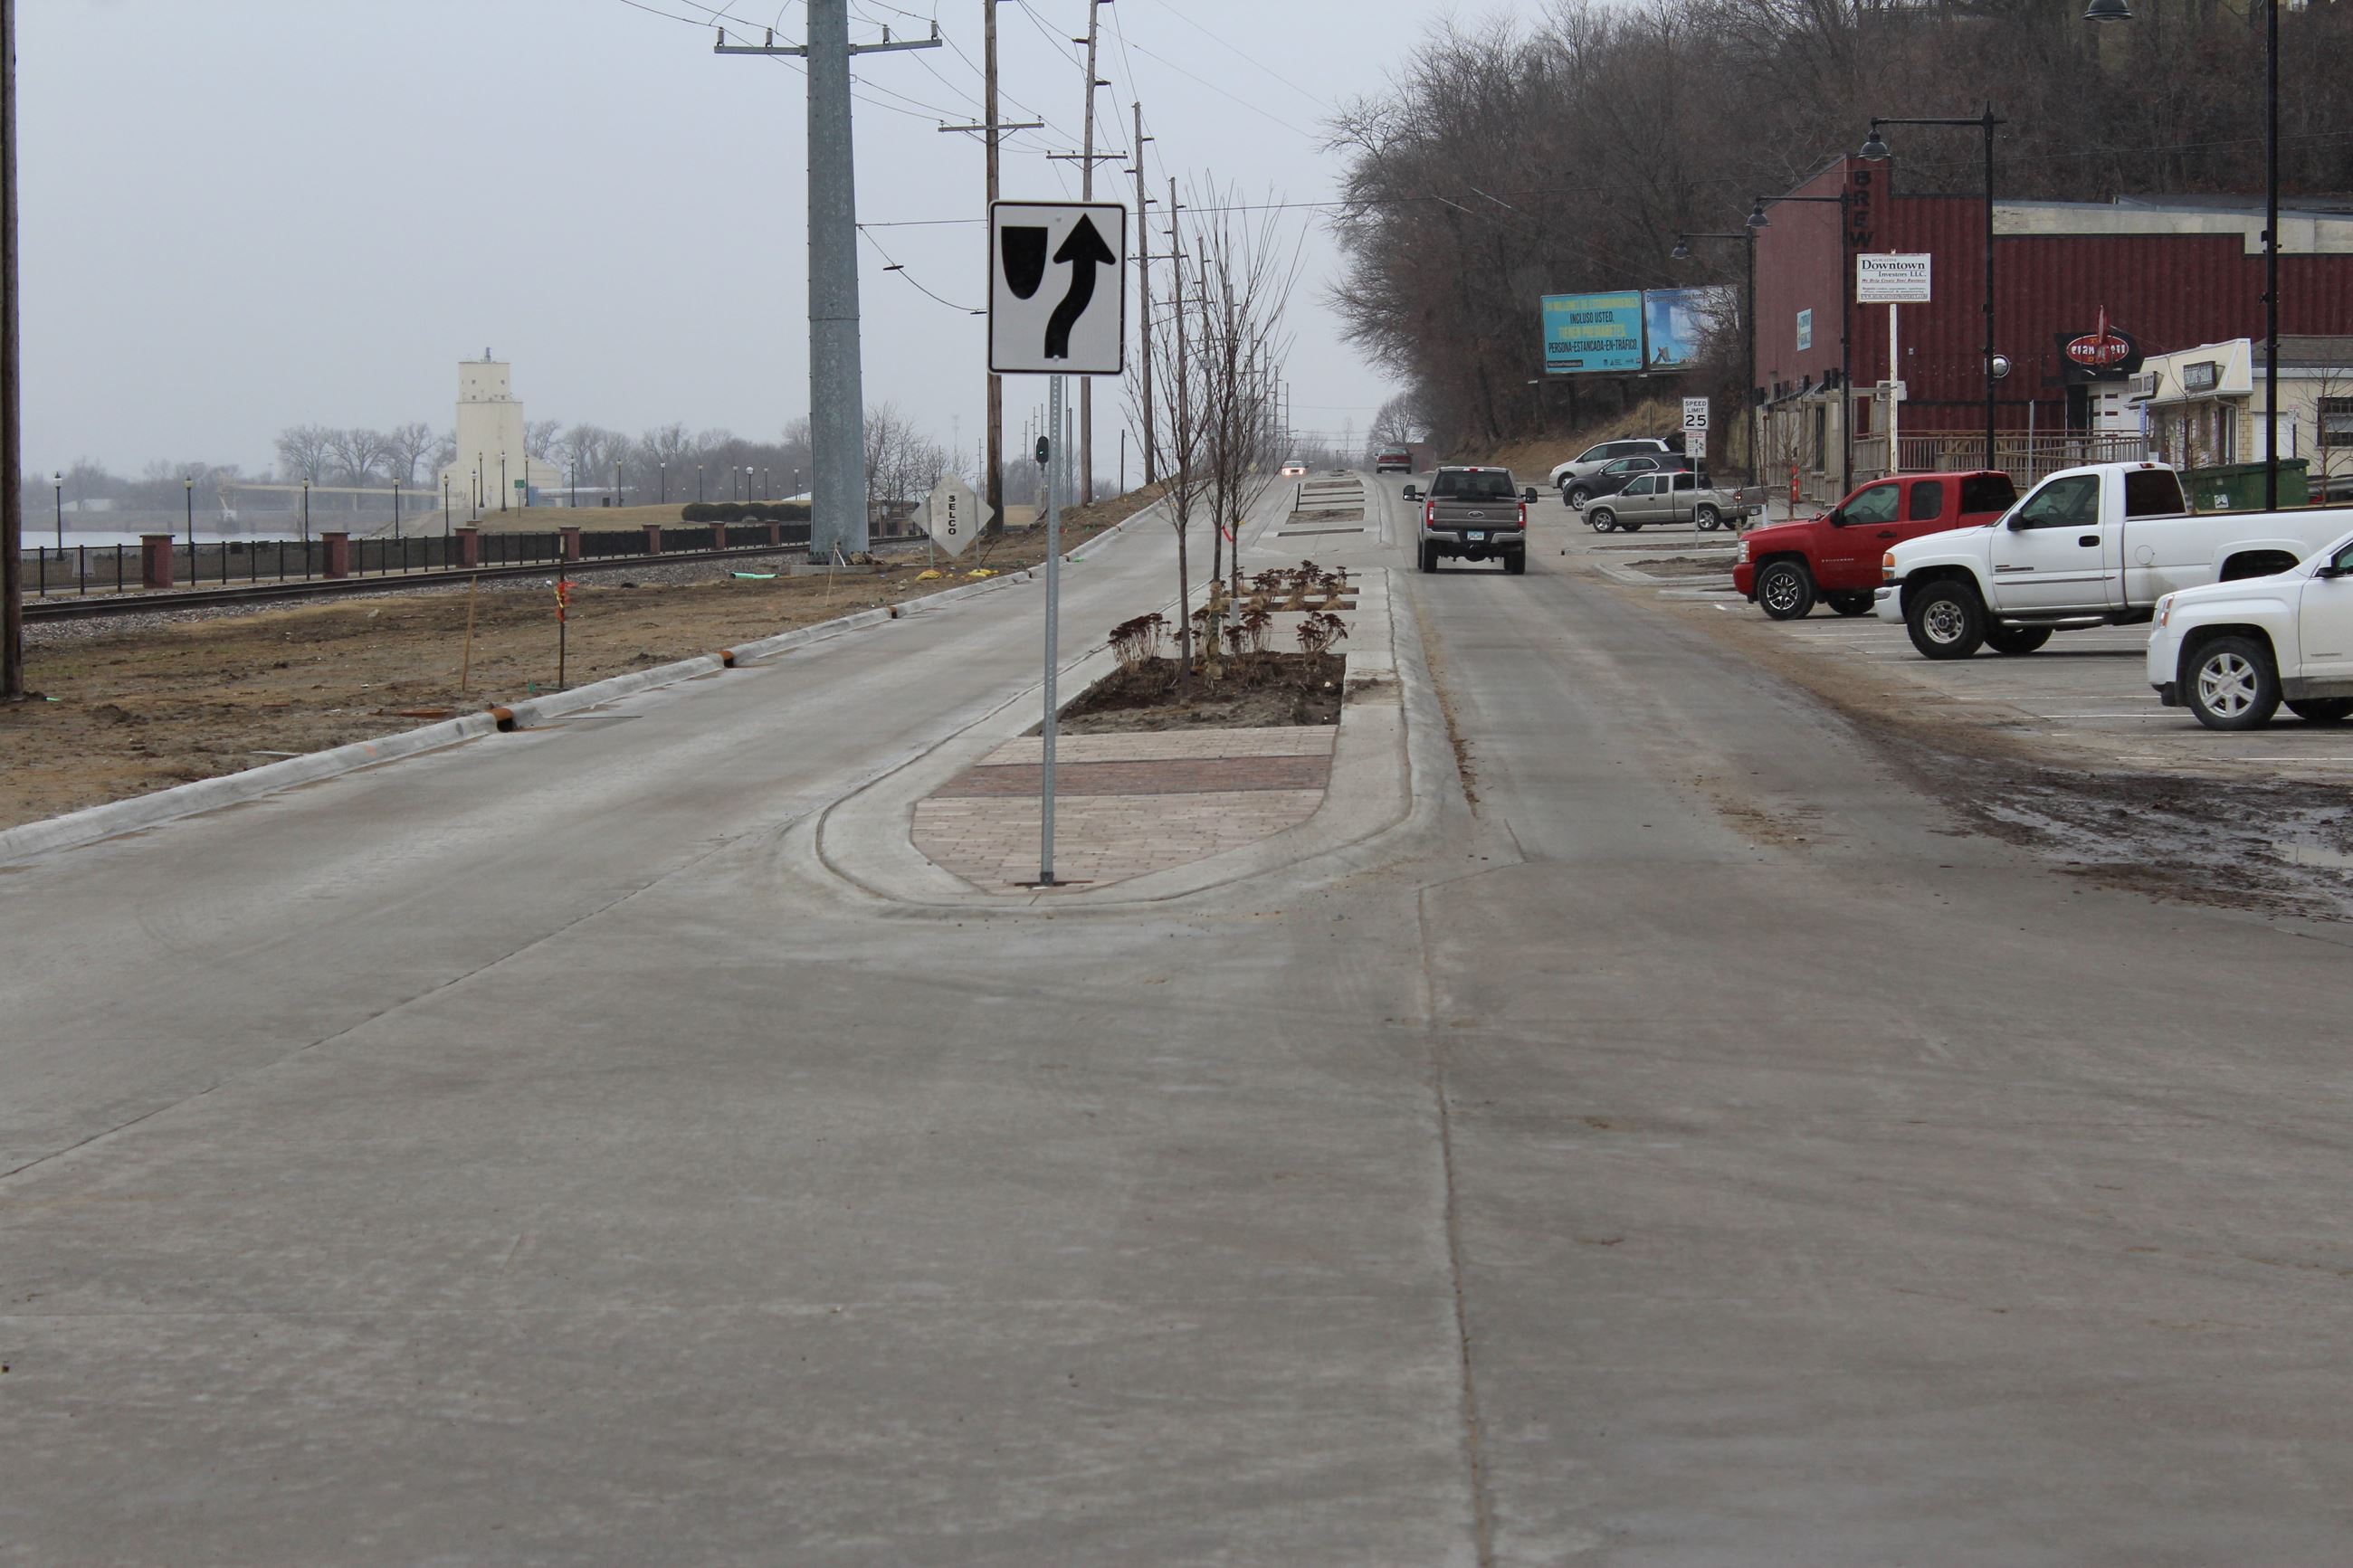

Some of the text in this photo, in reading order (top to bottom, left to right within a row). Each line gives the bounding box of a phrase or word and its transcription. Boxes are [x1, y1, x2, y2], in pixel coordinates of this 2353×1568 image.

[1849, 170, 1873, 248] BREW
[1862, 260, 1925, 270] Downtown
[1569, 312, 1594, 324] INCLUSO
[1685, 414, 1707, 426] 25
[948, 495, 957, 536] SELCO
